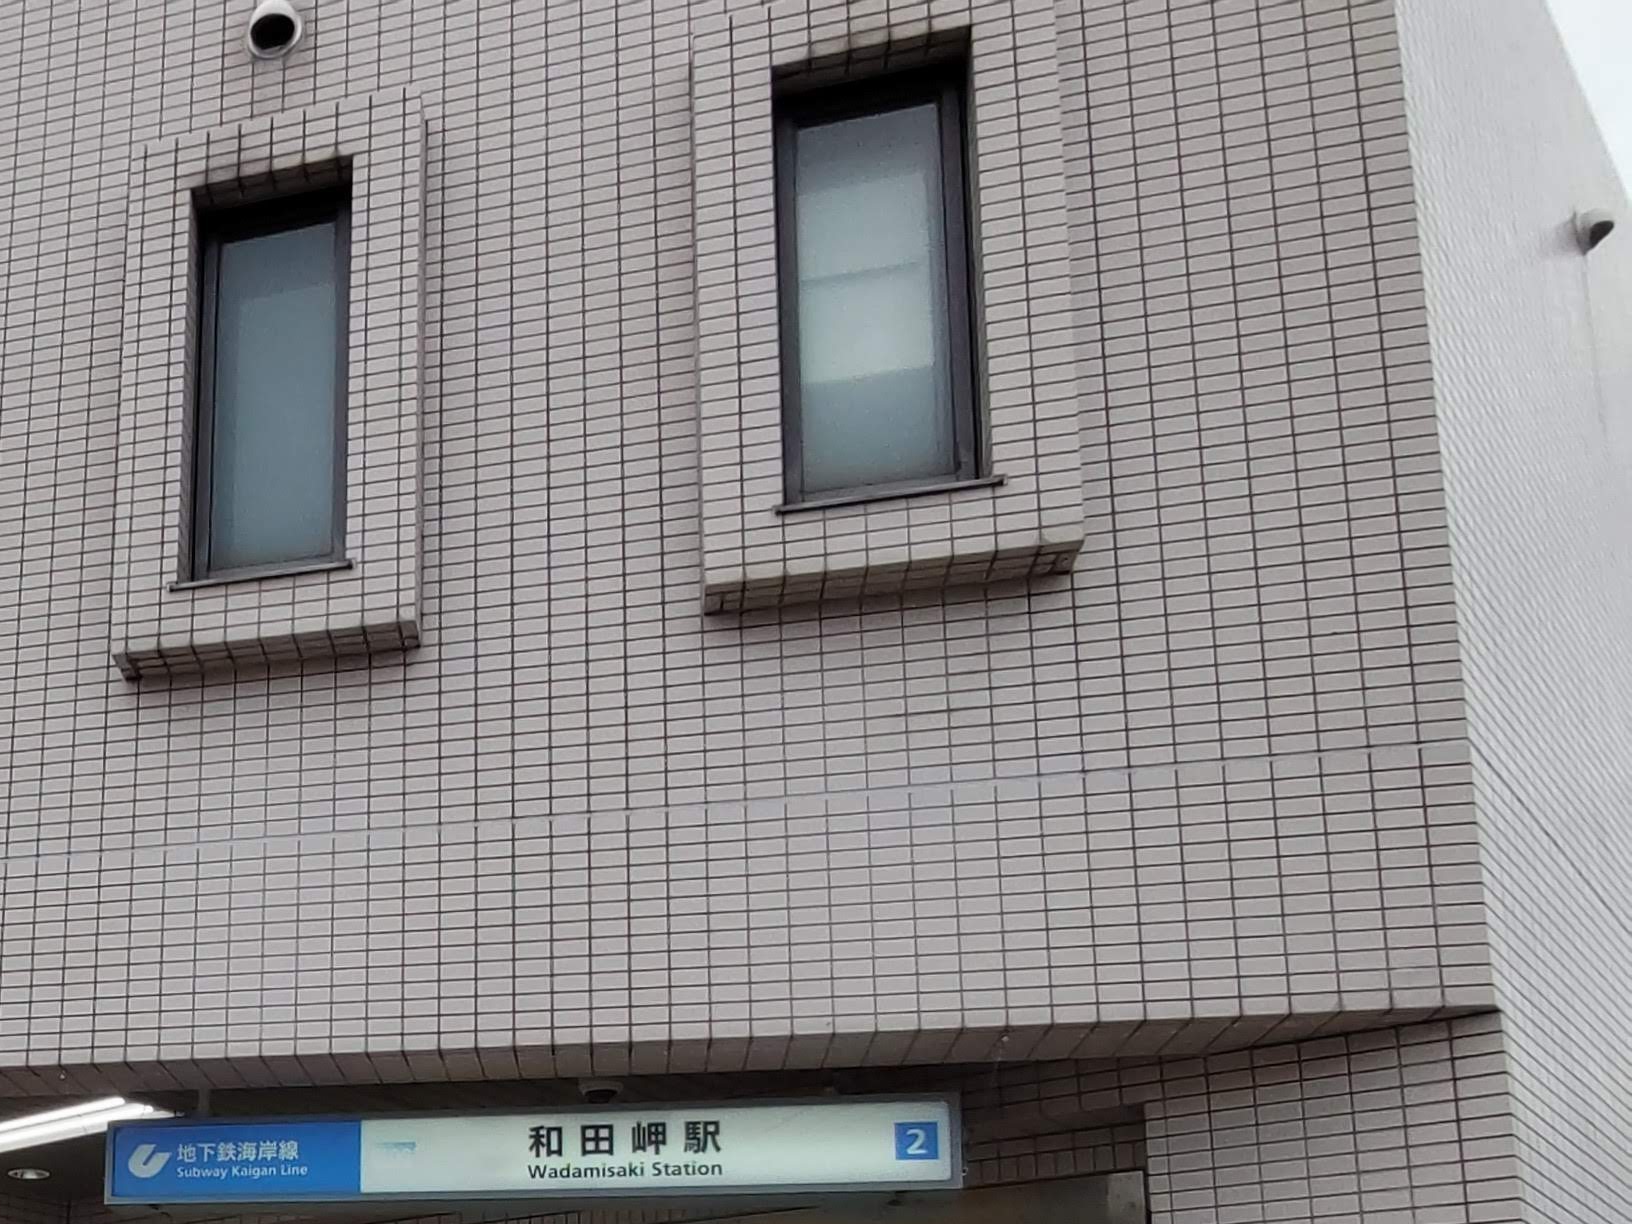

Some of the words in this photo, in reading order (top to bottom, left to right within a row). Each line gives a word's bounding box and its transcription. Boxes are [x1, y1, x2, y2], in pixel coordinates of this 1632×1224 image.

[528, 1119, 722, 1158] 和田岬駅
[905, 1128, 927, 1155] 2
[177, 1140, 299, 1163] 地下鉄海岸線
[177, 1166, 228, 1181] Subway
[231, 1164, 277, 1180] Kaigan
[280, 1163, 308, 1176] Line
[528, 1161, 645, 1179] Wadamisaki
[651, 1160, 723, 1177] Station
